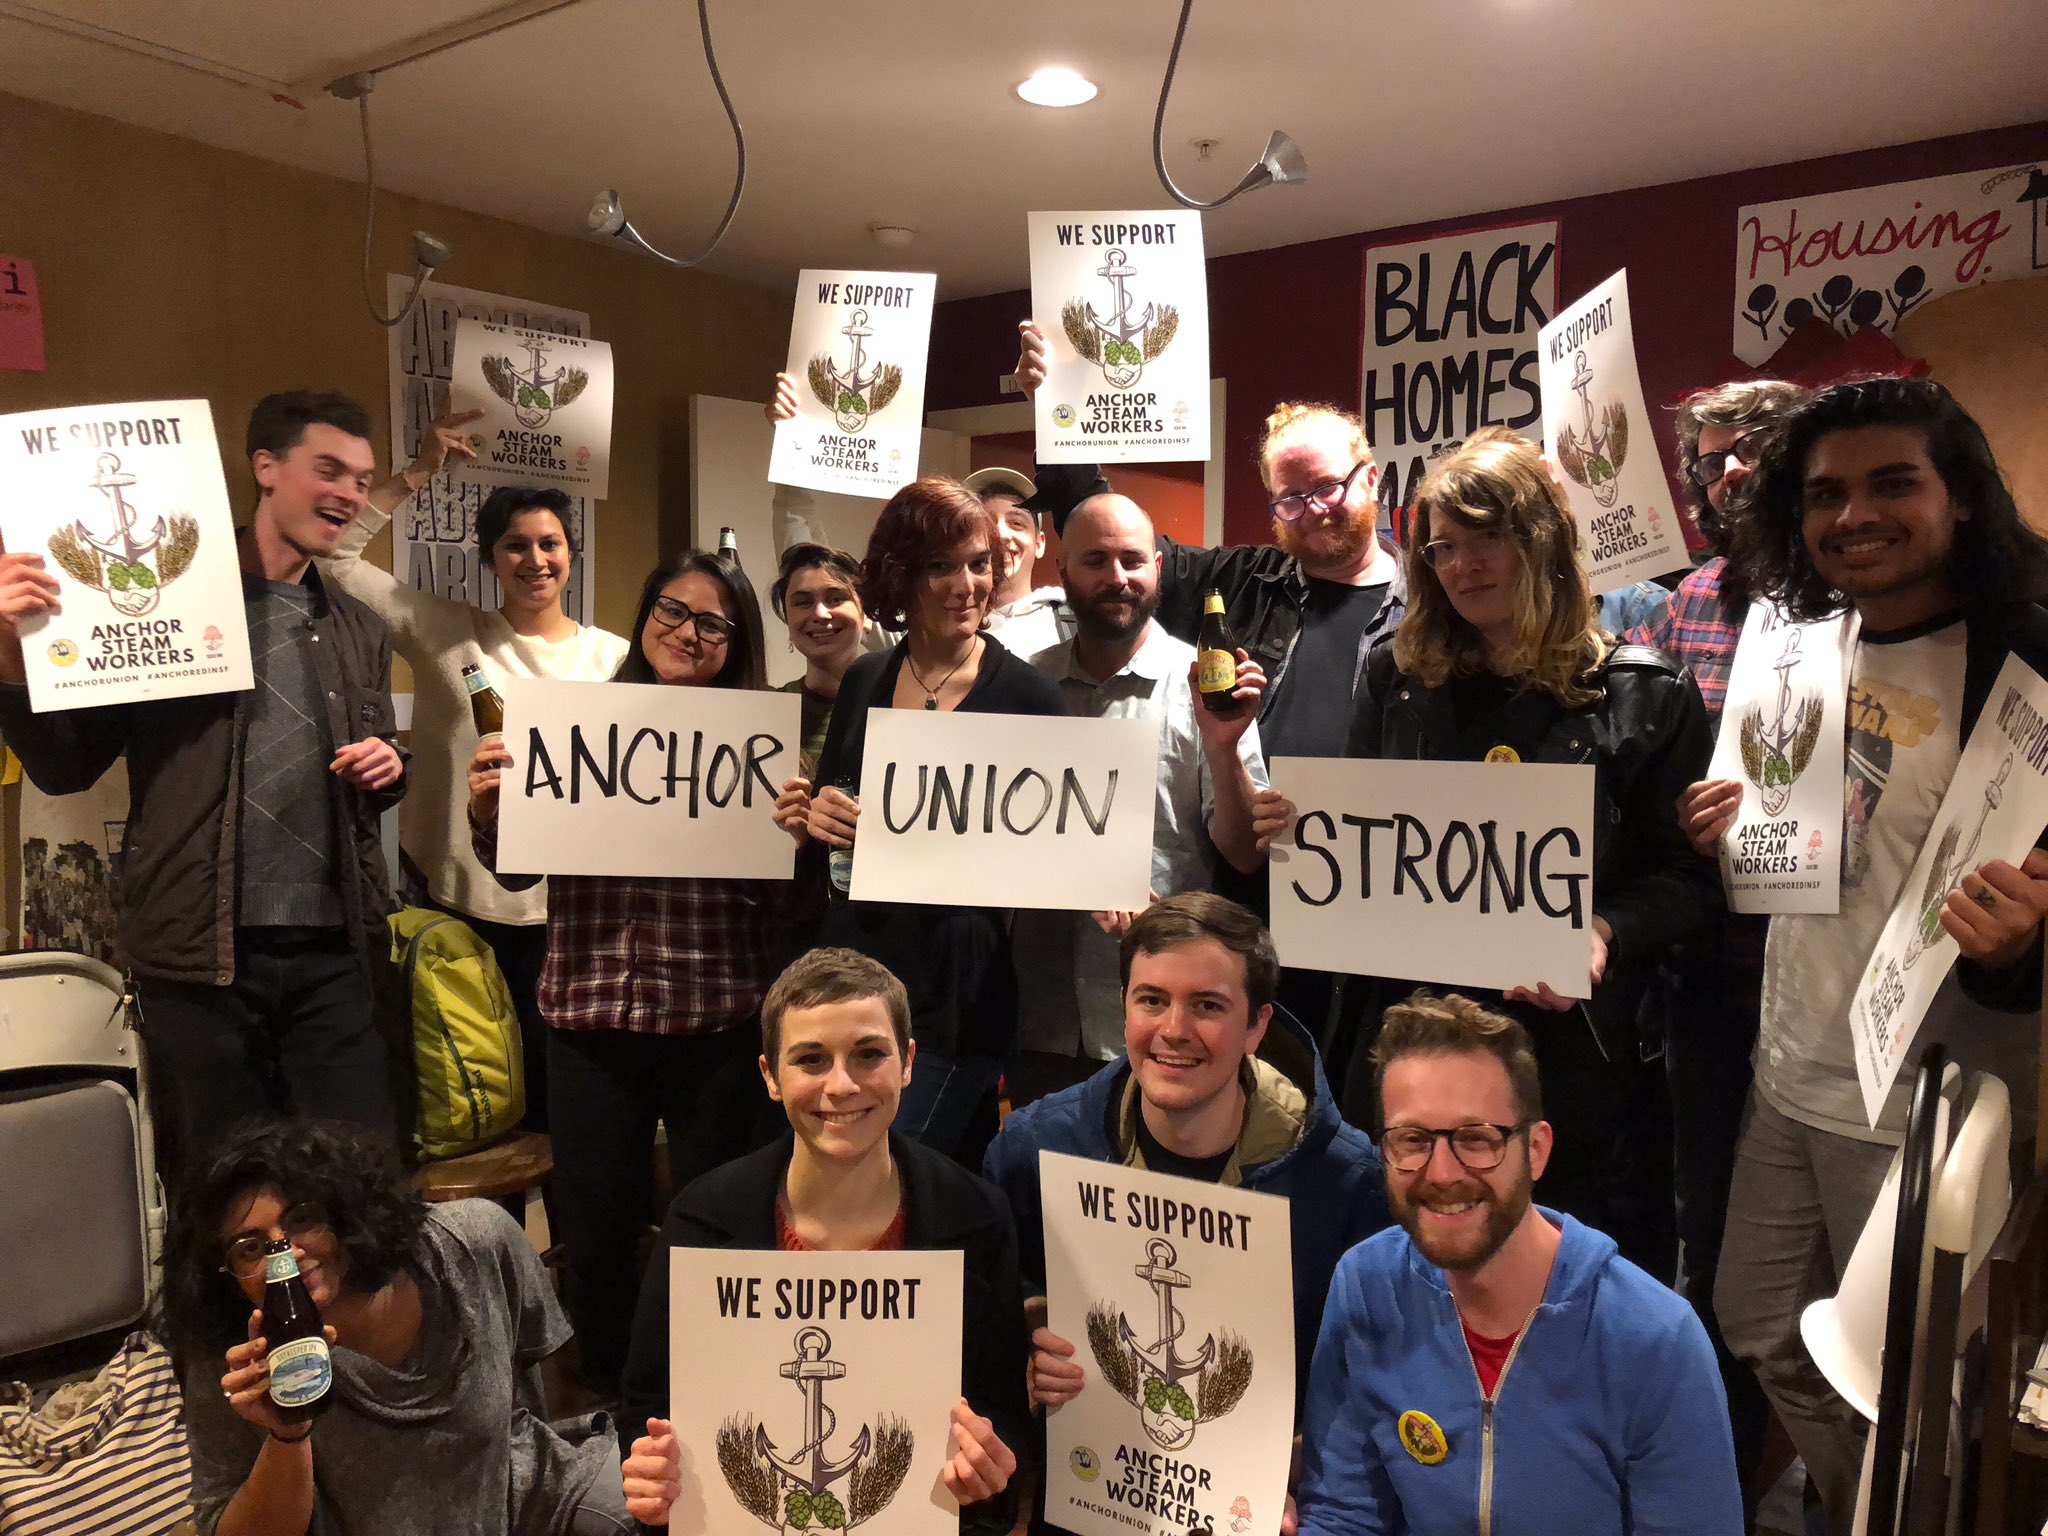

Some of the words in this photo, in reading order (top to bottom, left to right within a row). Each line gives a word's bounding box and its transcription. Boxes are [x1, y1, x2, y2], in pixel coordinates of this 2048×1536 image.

[1057, 224, 1084, 246] WE
[1092, 223, 1176, 246] SUPPORT
[1742, 202, 2012, 283] Housing
[818, 283, 840, 304] WE
[843, 284, 914, 308] SUPPORT
[1374, 241, 1556, 347] BLACK
[483, 323, 507, 334] WE
[514, 328, 589, 349] SUPPORT
[1550, 334, 1565, 365] WE
[1566, 298, 1614, 354] SUPPORT
[1086, 393, 1157, 407] ANCHOR
[1365, 347, 1543, 448] HOMES
[1093, 406, 1147, 420] STEAM
[497, 429, 563, 447] ANCHOR
[1080, 420, 1164, 434] WORKERS
[21, 427, 60, 455] WE
[503, 441, 552, 457] STEAM
[818, 434, 877, 450] ANCHOR
[822, 446, 867, 460] STEAM
[1054, 439, 1119, 447] #ANCHORUNION
[1124, 437, 1191, 445] #ANCHOREDINSF
[491, 451, 567, 471] WORKERS
[811, 455, 880, 473] WORKERS
[1590, 504, 1637, 534] ANCHOR
[1597, 524, 1634, 546] STEAM
[1591, 532, 1648, 563] WORKERS
[91, 619, 184, 641] ANCHOR
[102, 635, 172, 655] STEAM
[87, 649, 195, 672] WORKERS
[55, 675, 140, 690] #ANCHORUNION
[147, 666, 230, 681] #ANCHOREDINSF
[1995, 686, 2022, 733] WE
[525, 722, 784, 819] ANCHOR
[882, 760, 1119, 837] UNION
[1738, 821, 1799, 841] ANCHOR
[1741, 839, 1788, 857] STEAM
[1290, 810, 1590, 930] STRONG
[1732, 856, 1798, 875] WORKERS
[1764, 881, 1821, 890] #ANCHOREDINSF
[1078, 1181, 1117, 1223] WE
[1127, 1191, 1252, 1251] SUPPORT
[716, 1276, 762, 1319] WE
[774, 1278, 921, 1320] SUPPORT
[1114, 1444, 1212, 1491] ANCHOR
[1122, 1465, 1195, 1507] STEAM
[1069, 1496, 1152, 1534] #ANCHORUNION
[1105, 1479, 1215, 1536] WORKERS
